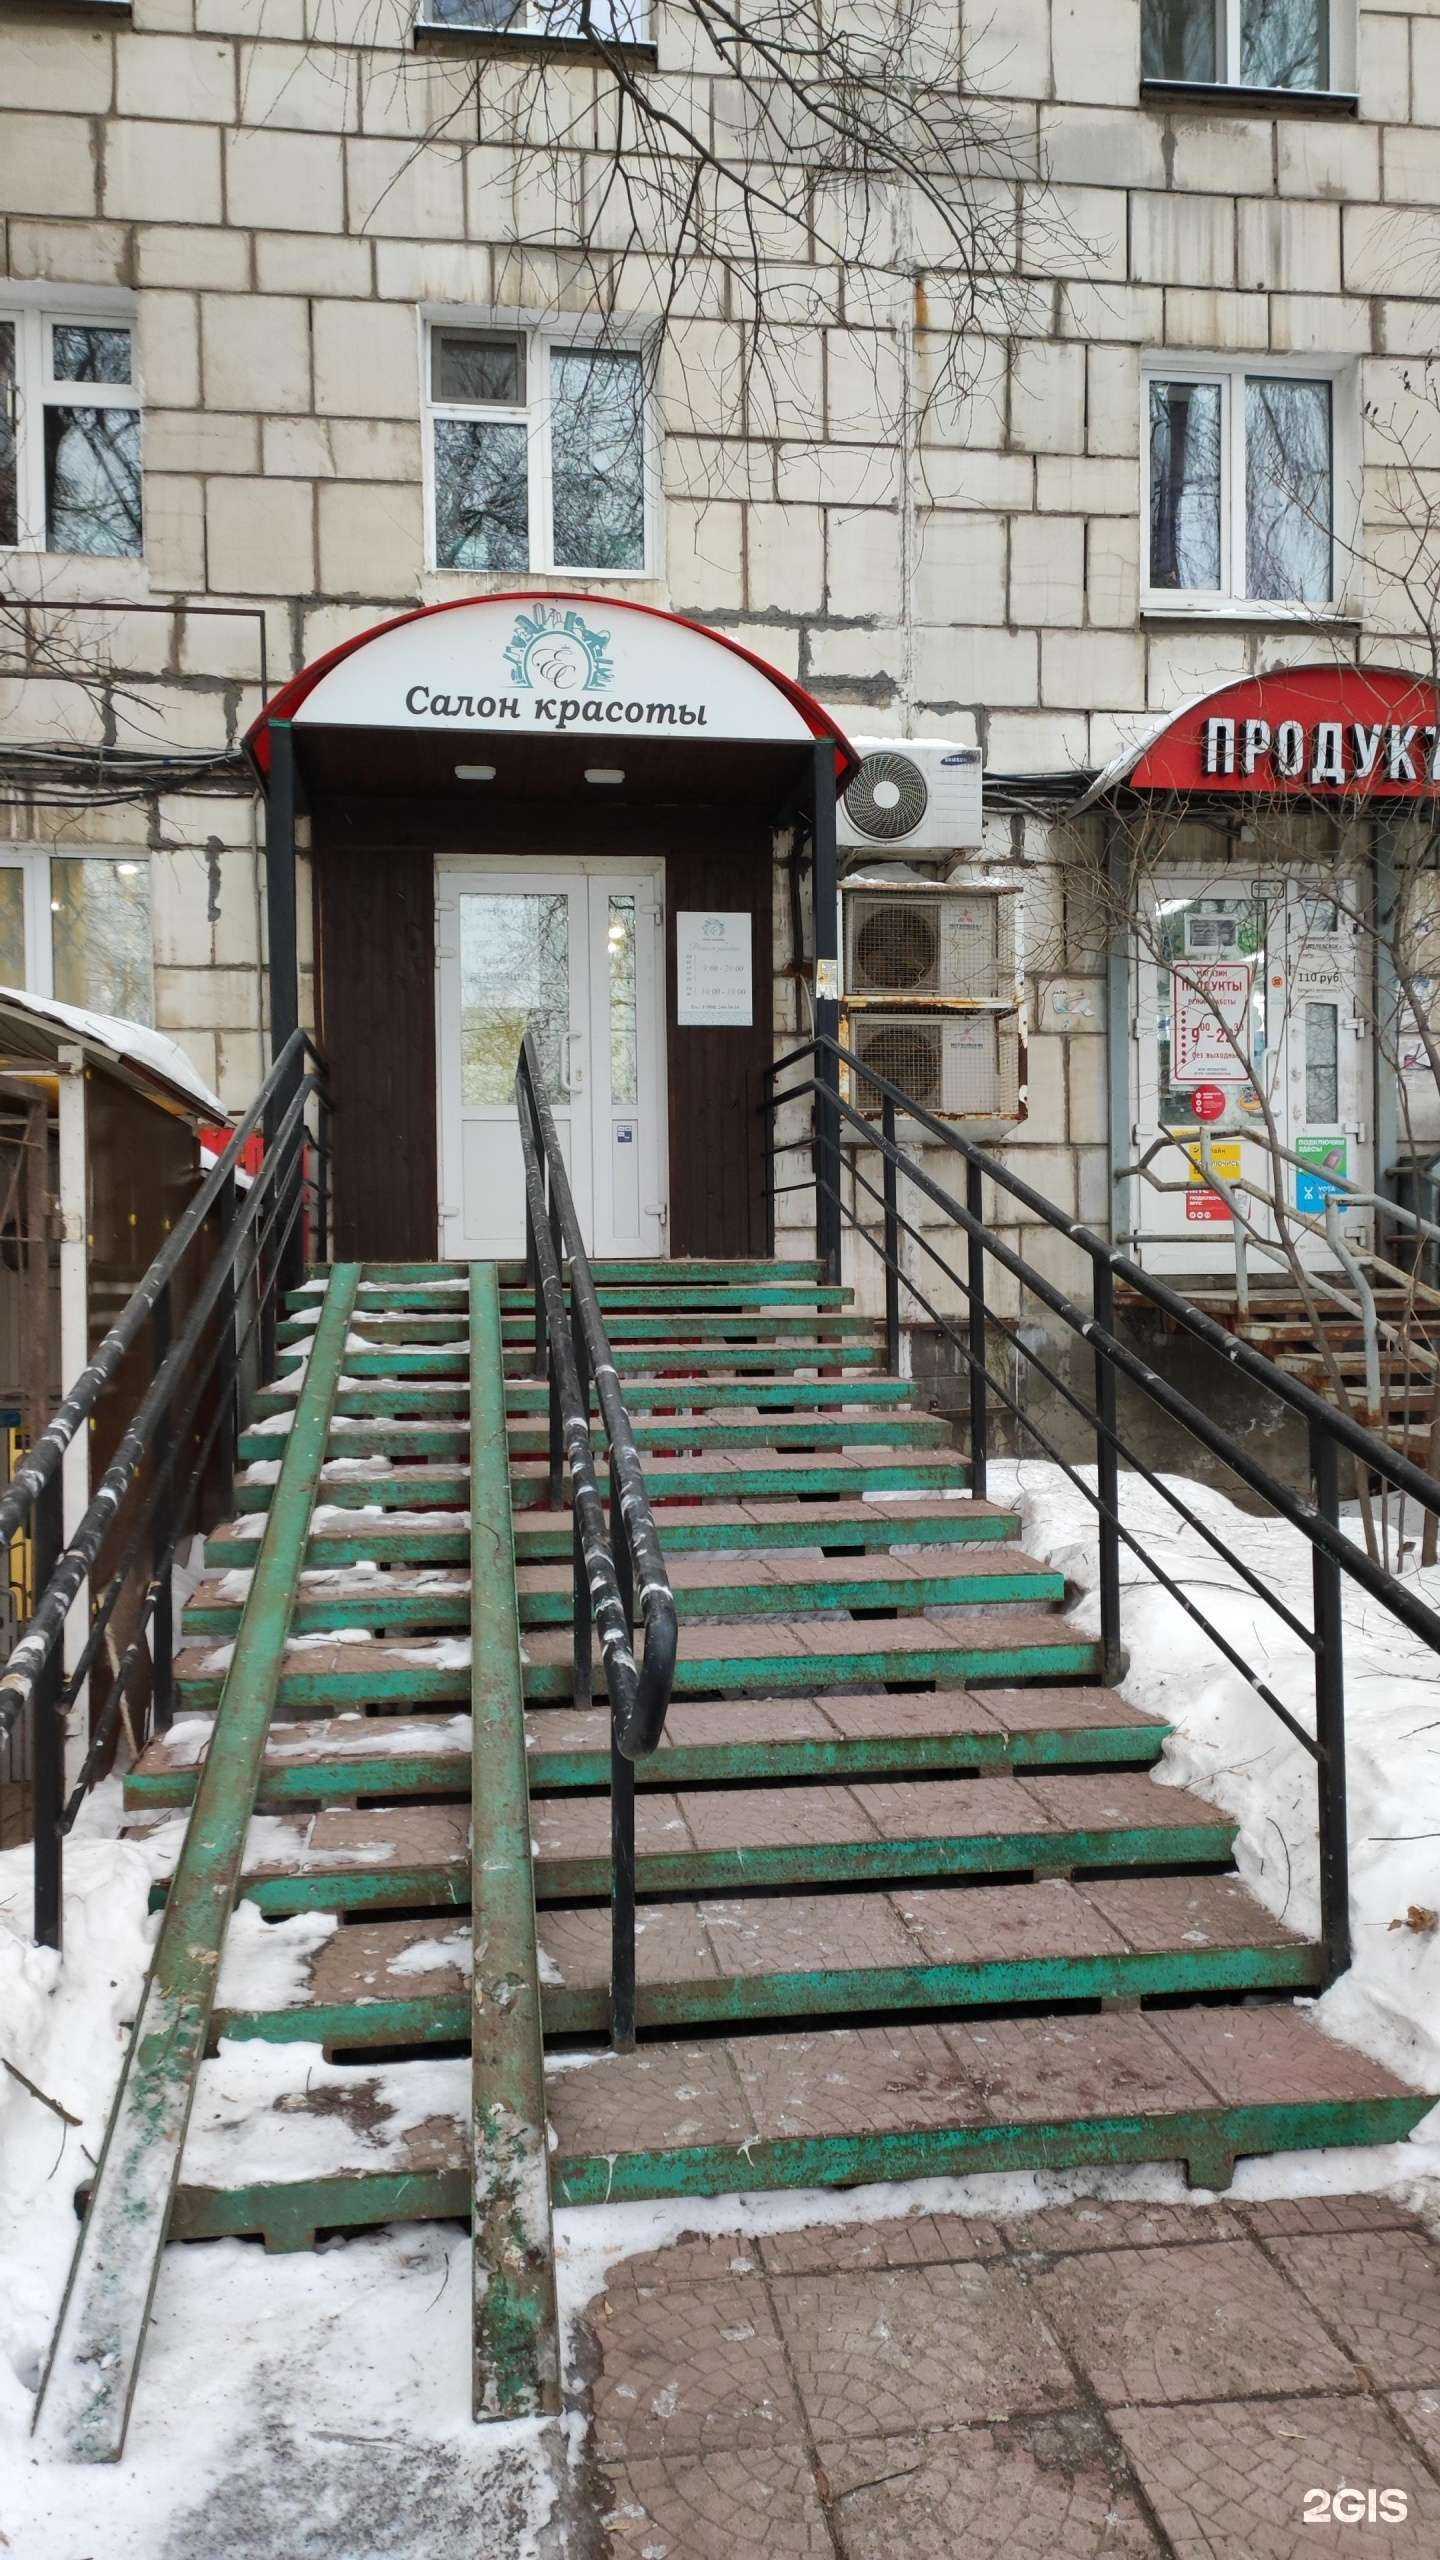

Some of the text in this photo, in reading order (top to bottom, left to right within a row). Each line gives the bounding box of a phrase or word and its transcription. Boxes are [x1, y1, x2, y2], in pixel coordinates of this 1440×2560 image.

[405, 685, 708, 729] Салон красоты
[1298, 972, 1317, 982] 110
